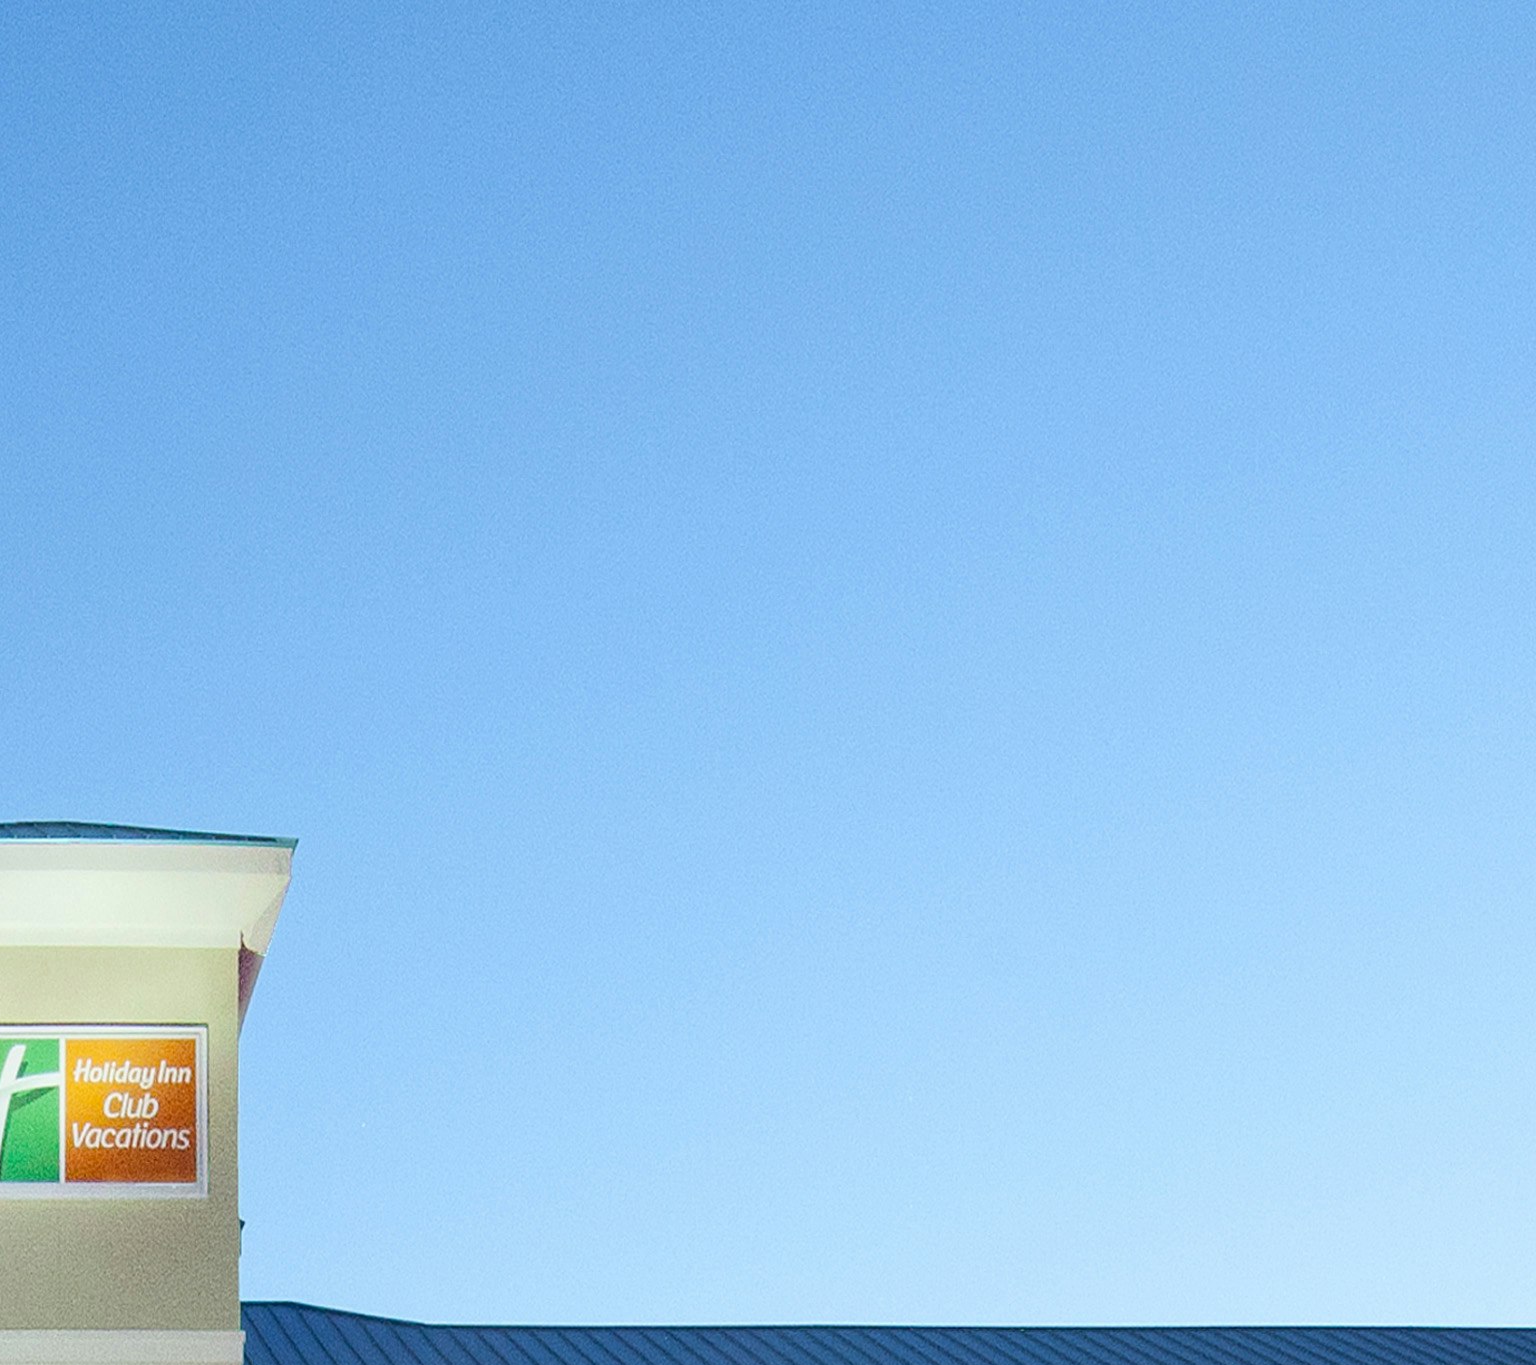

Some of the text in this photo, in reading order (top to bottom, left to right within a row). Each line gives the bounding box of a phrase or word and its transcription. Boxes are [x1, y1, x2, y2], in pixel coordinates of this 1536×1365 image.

[73, 1059, 191, 1089] Holiday Inn
[103, 1091, 159, 1118] Club
[72, 1122, 191, 1150] Vacations
